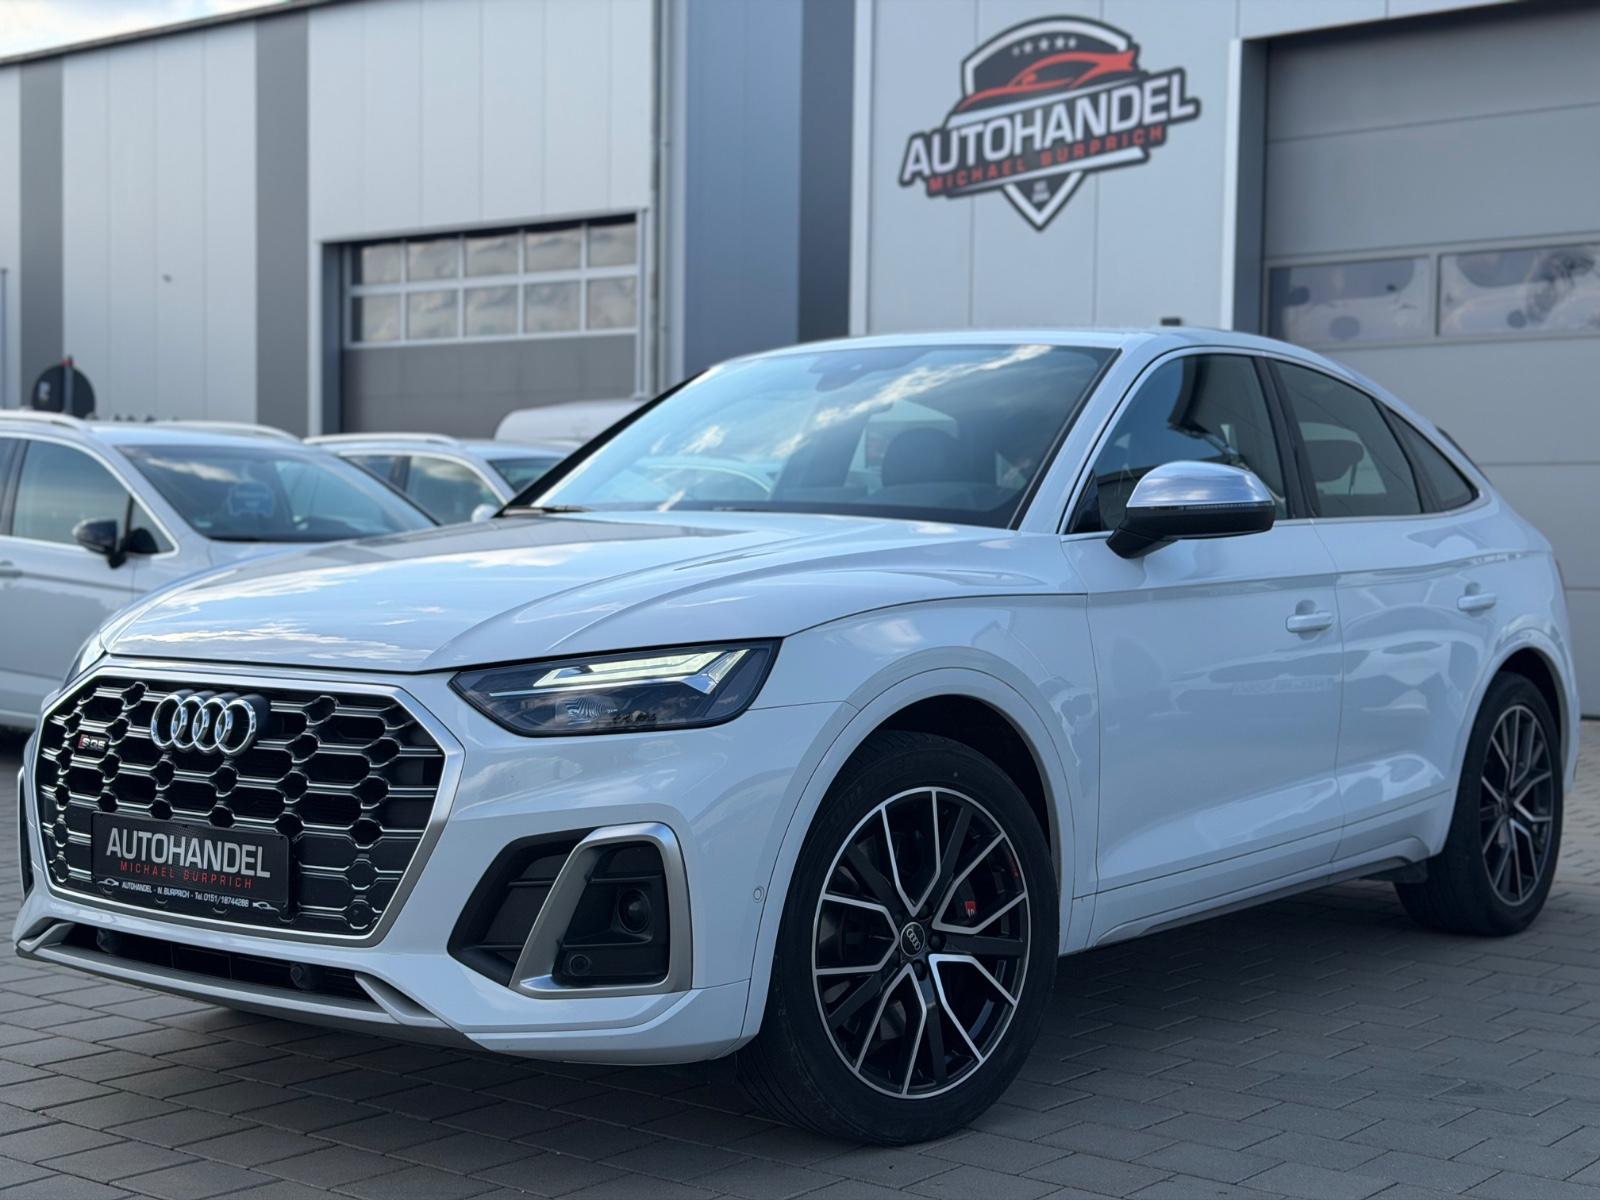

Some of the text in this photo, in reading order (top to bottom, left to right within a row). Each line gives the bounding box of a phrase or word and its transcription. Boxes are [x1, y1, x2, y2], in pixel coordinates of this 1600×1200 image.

[902, 73, 1196, 182] AUTOHANDEL
[927, 158, 1026, 192] MICHAEL
[106, 827, 271, 878] AUTOHANDEL
[120, 861, 253, 889] MICHAEL BURPRICH
[121, 881, 153, 894] AUTOHANDEL
